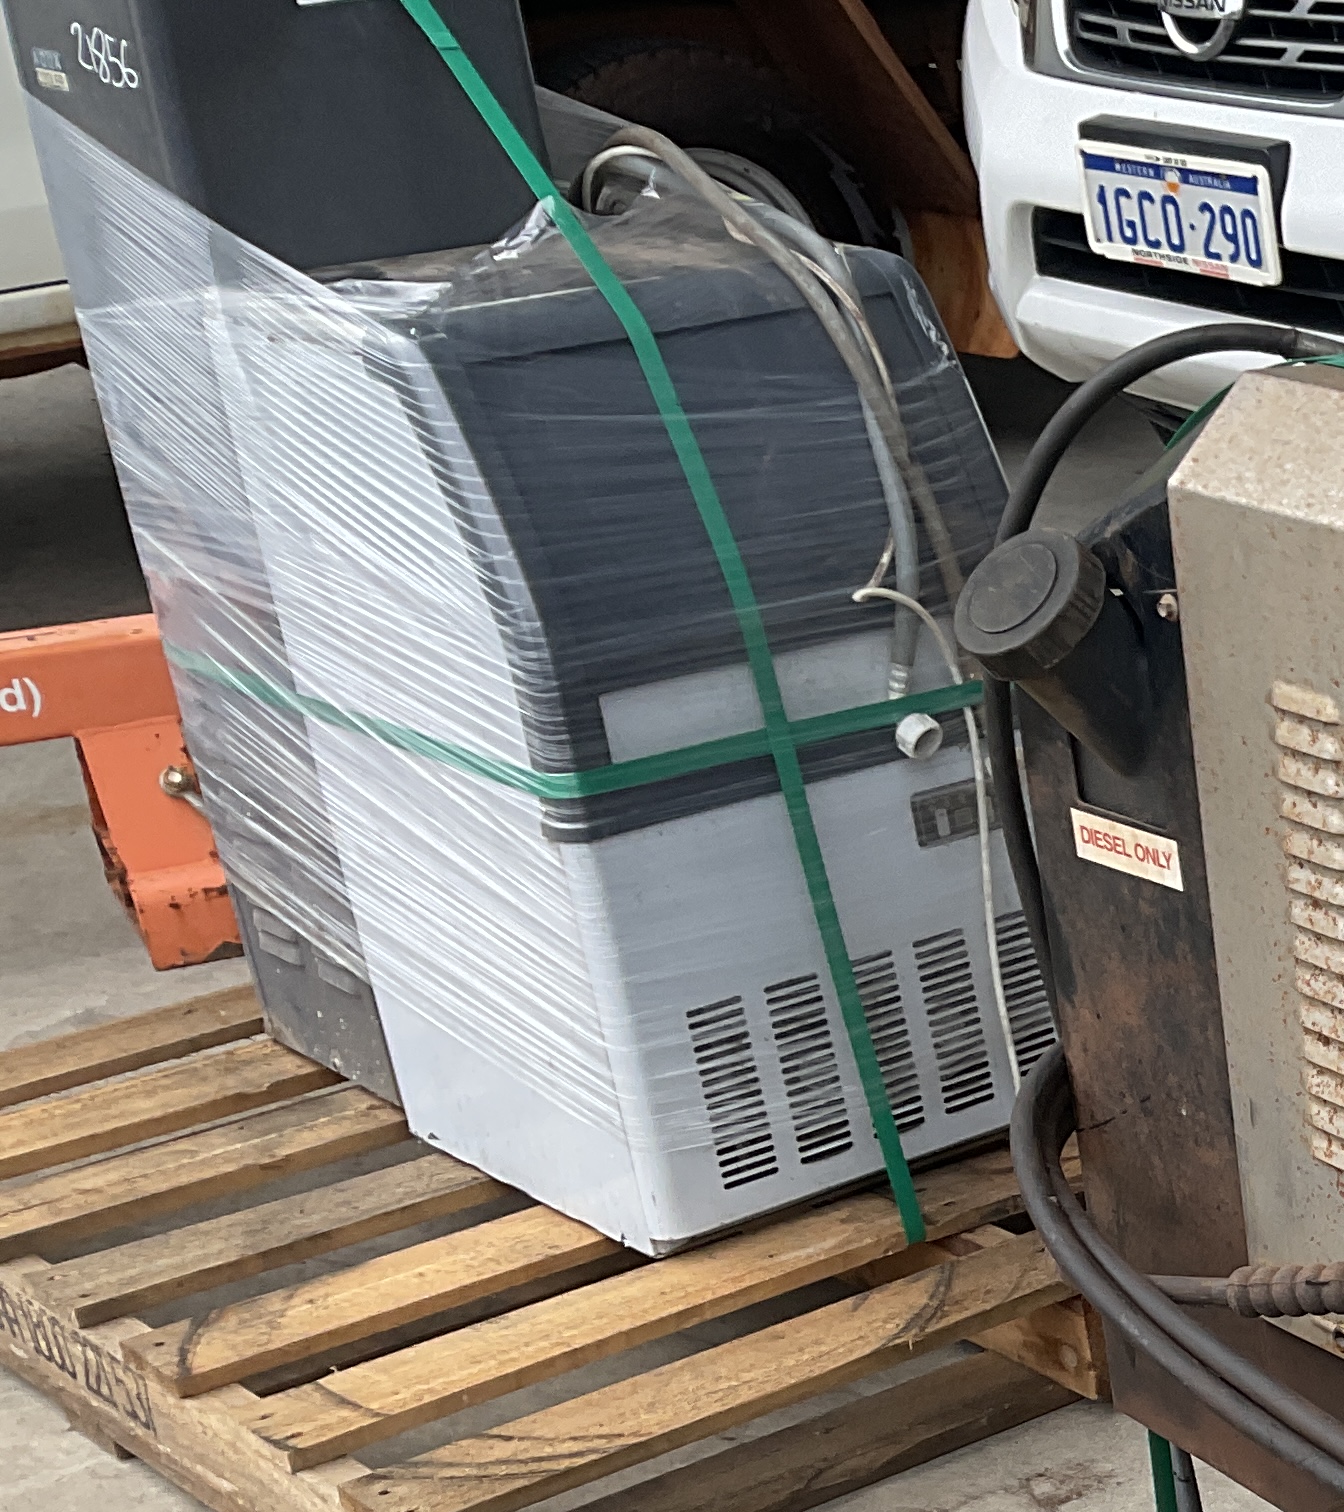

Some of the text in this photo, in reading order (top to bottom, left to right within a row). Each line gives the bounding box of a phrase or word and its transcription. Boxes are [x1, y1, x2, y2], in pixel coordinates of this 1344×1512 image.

[1114, 161, 1231, 190] WESTERN AUSTRALIA
[1079, 824, 1173, 870] DIESEL ONLY
